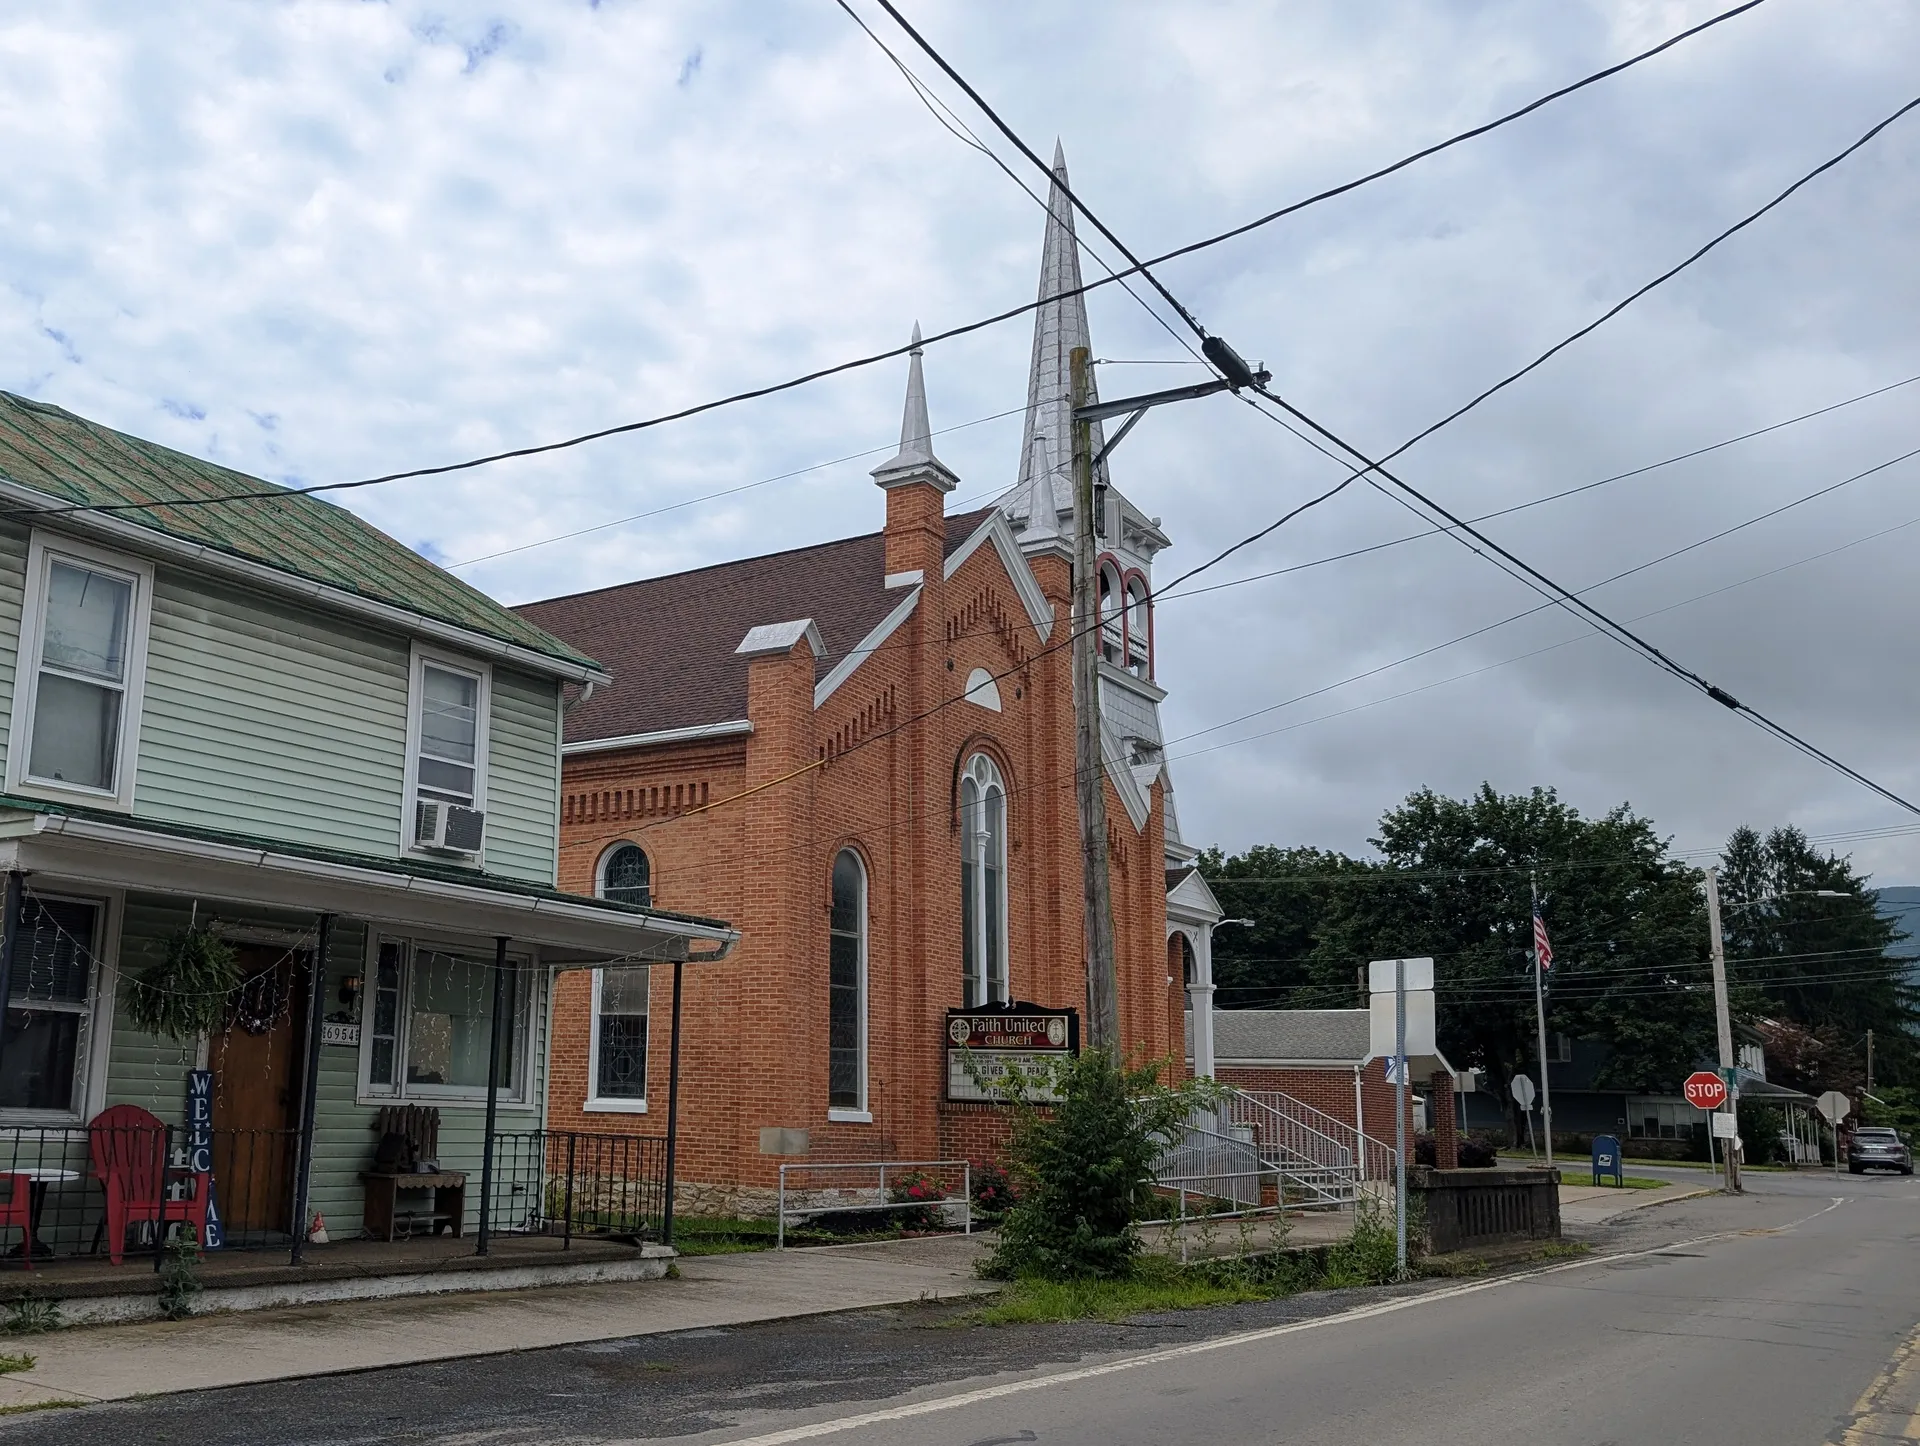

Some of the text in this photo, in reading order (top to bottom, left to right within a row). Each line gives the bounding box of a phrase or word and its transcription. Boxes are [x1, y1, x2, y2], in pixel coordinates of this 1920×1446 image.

[971, 1018, 1001, 1032] Faith
[1005, 1018, 1046, 1033] United
[327, 1027, 354, 1041] 6954
[984, 1035, 1032, 1045] CHURCH
[981, 1065, 1004, 1075] GIVES
[1688, 1084, 1723, 1098] STOP
